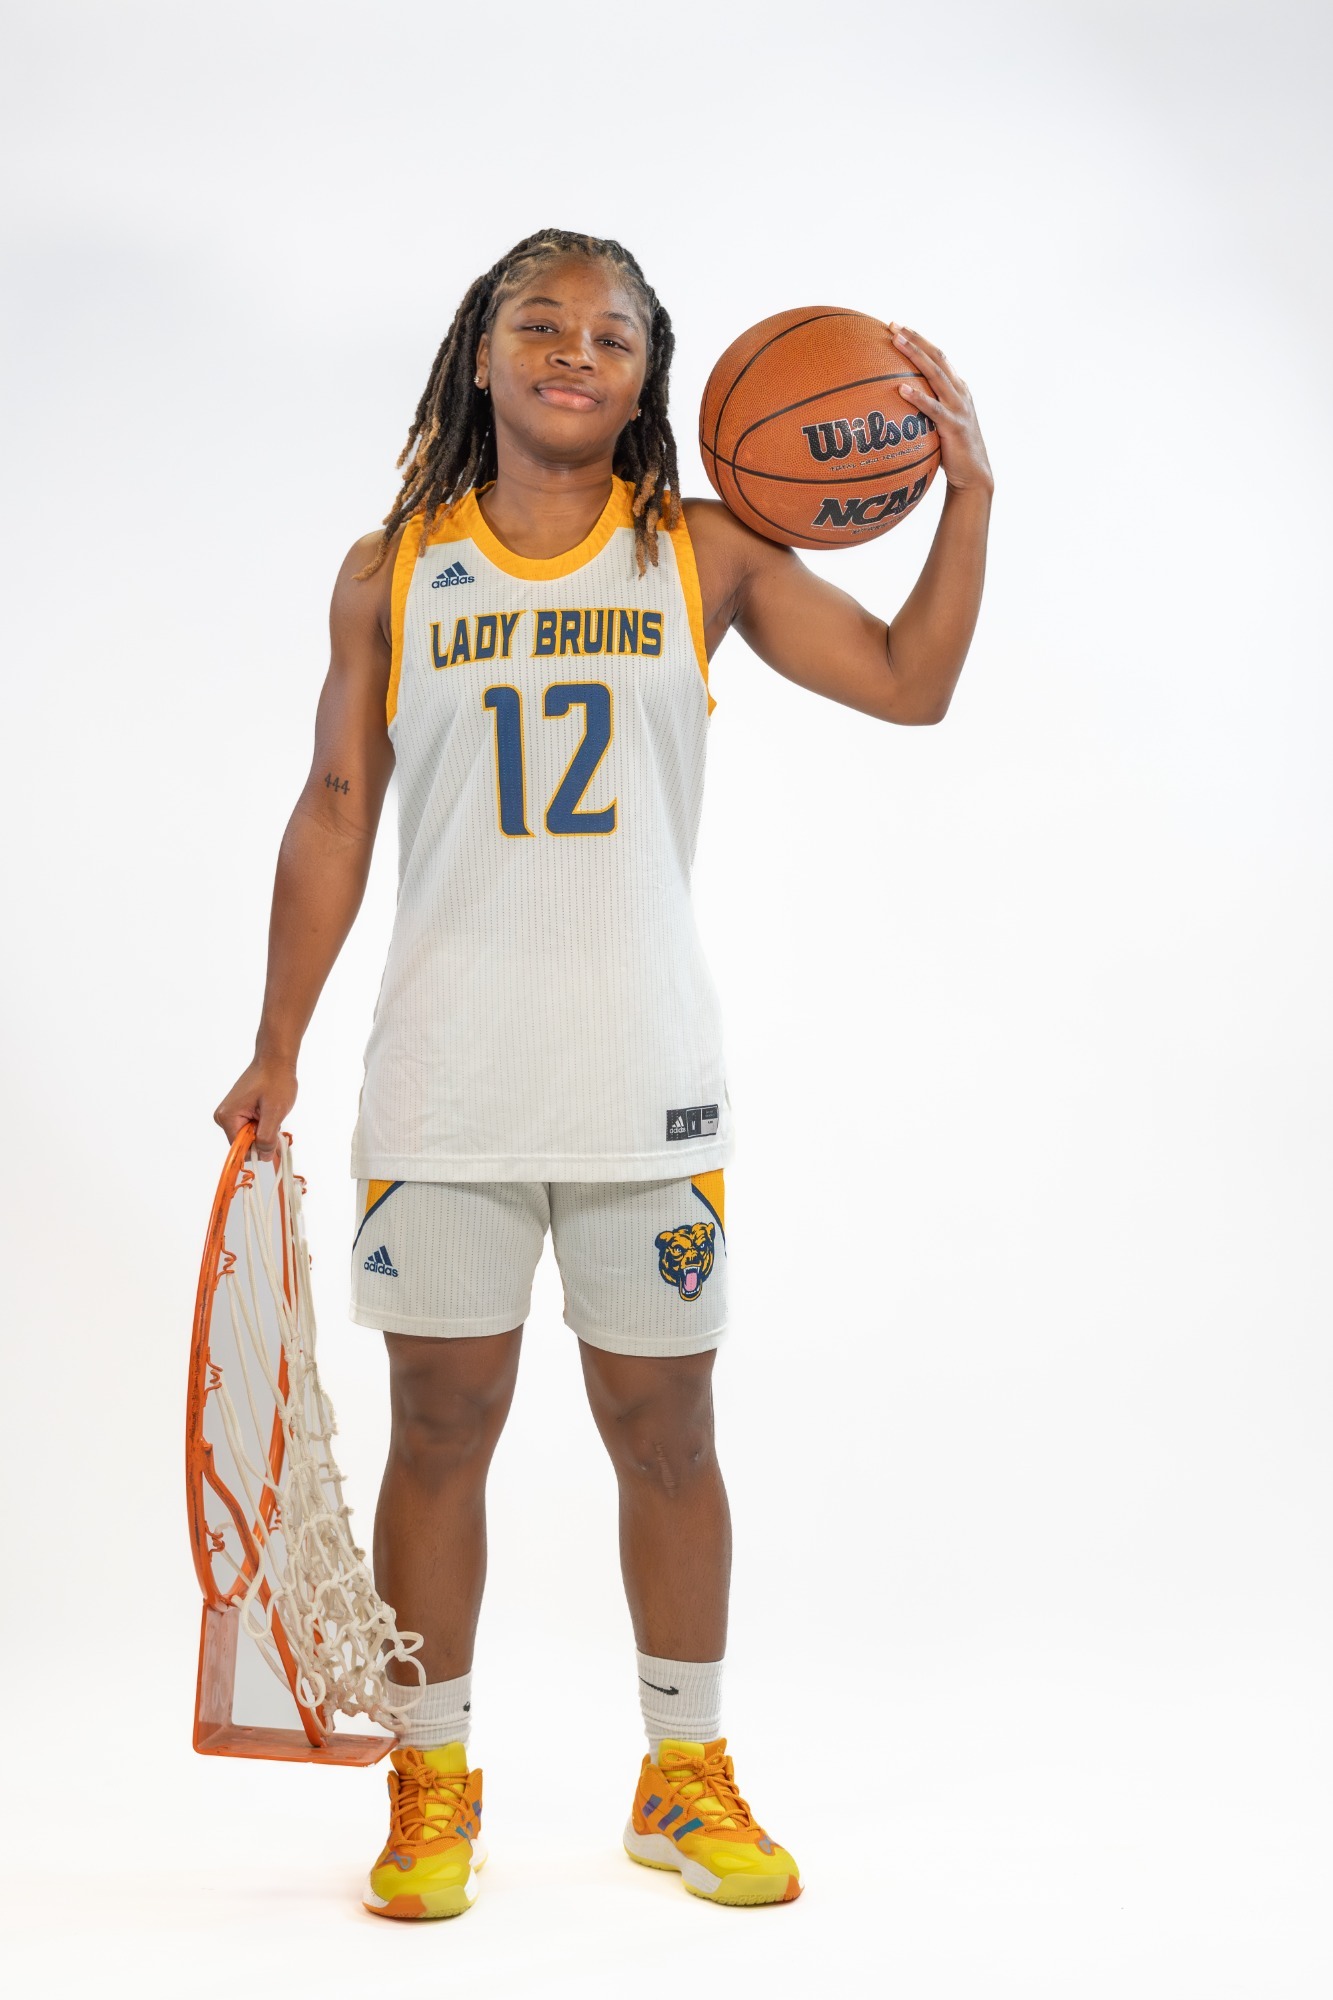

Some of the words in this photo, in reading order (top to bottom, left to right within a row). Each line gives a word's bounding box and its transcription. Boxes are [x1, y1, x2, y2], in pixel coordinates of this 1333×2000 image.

[801, 411, 936, 462] Wilson
[811, 473, 928, 528] NCAA
[431, 576, 475, 588] adidas
[430, 610, 527, 671] LADY
[530, 608, 664, 658] BRUINS
[324, 772, 350, 795] 444
[482, 681, 617, 838] 12
[364, 1261, 399, 1277] adidas
